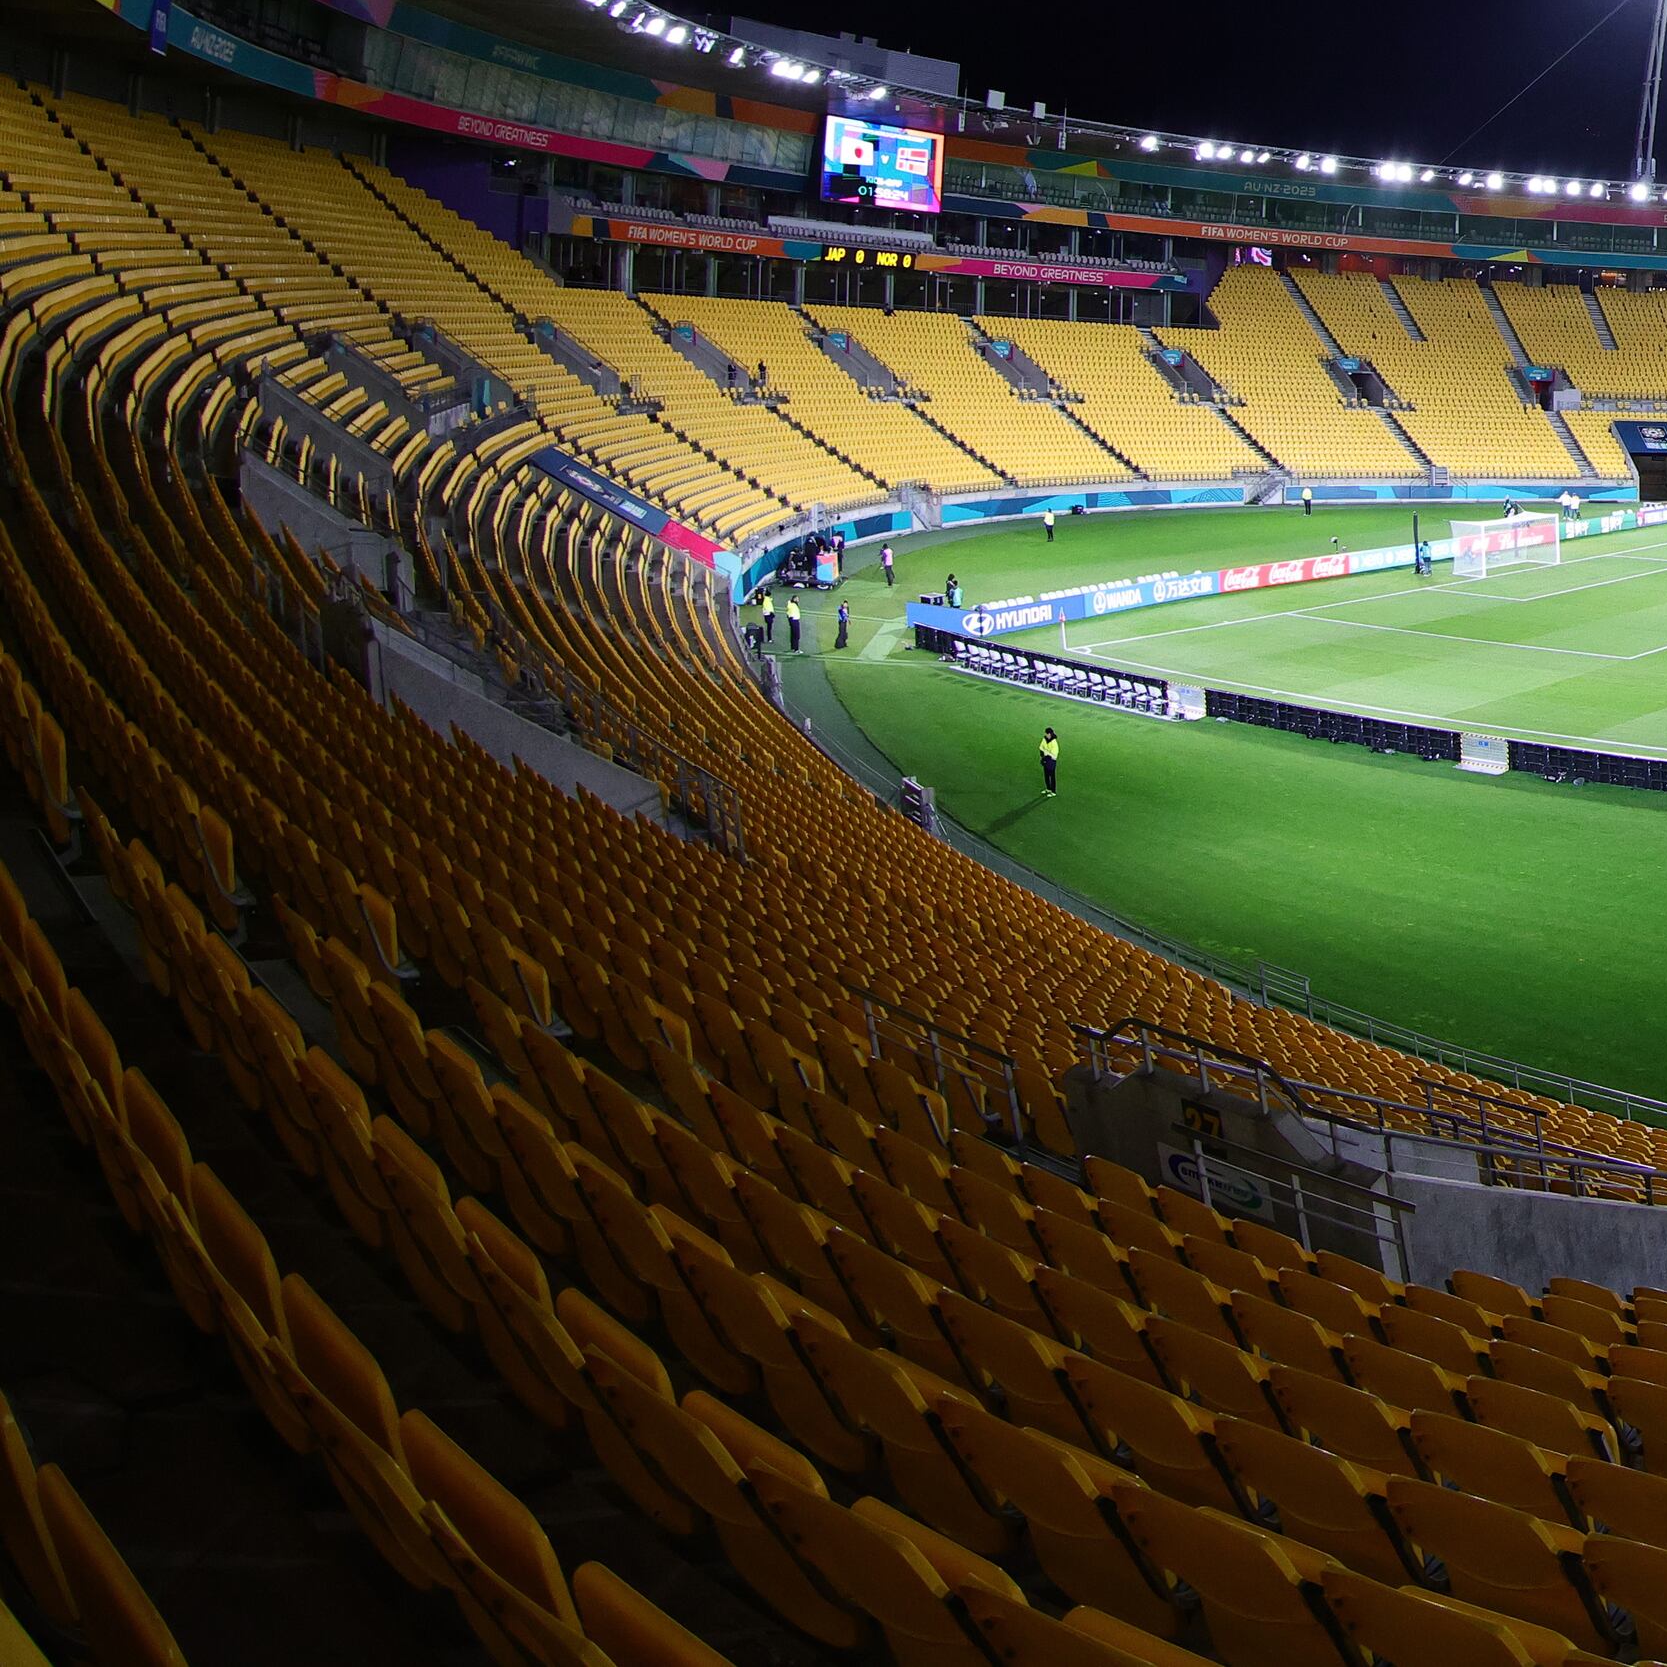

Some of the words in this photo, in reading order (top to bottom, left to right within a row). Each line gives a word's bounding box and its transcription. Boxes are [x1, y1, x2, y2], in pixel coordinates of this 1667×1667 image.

[457, 115, 494, 137] BEYOND
[628, 225, 648, 240] FIFA
[649, 228, 697, 245] WOMEN'S
[698, 233, 734, 249] WORLD
[735, 238, 758, 251] CUP
[1201, 226, 1225, 238] FIFA
[1226, 228, 1279, 242] WOMEN'S
[1282, 233, 1322, 246] WORLD
[1325, 237, 1349, 247] CUP
[824, 247, 847, 262] JAP
[876, 251, 898, 267] NOR
[993, 263, 1038, 278] BEYOND
[1106, 588, 1143, 610] WANDA
[996, 604, 1053, 630] HYUNDAI
[1184, 1106, 1221, 1138] 27
